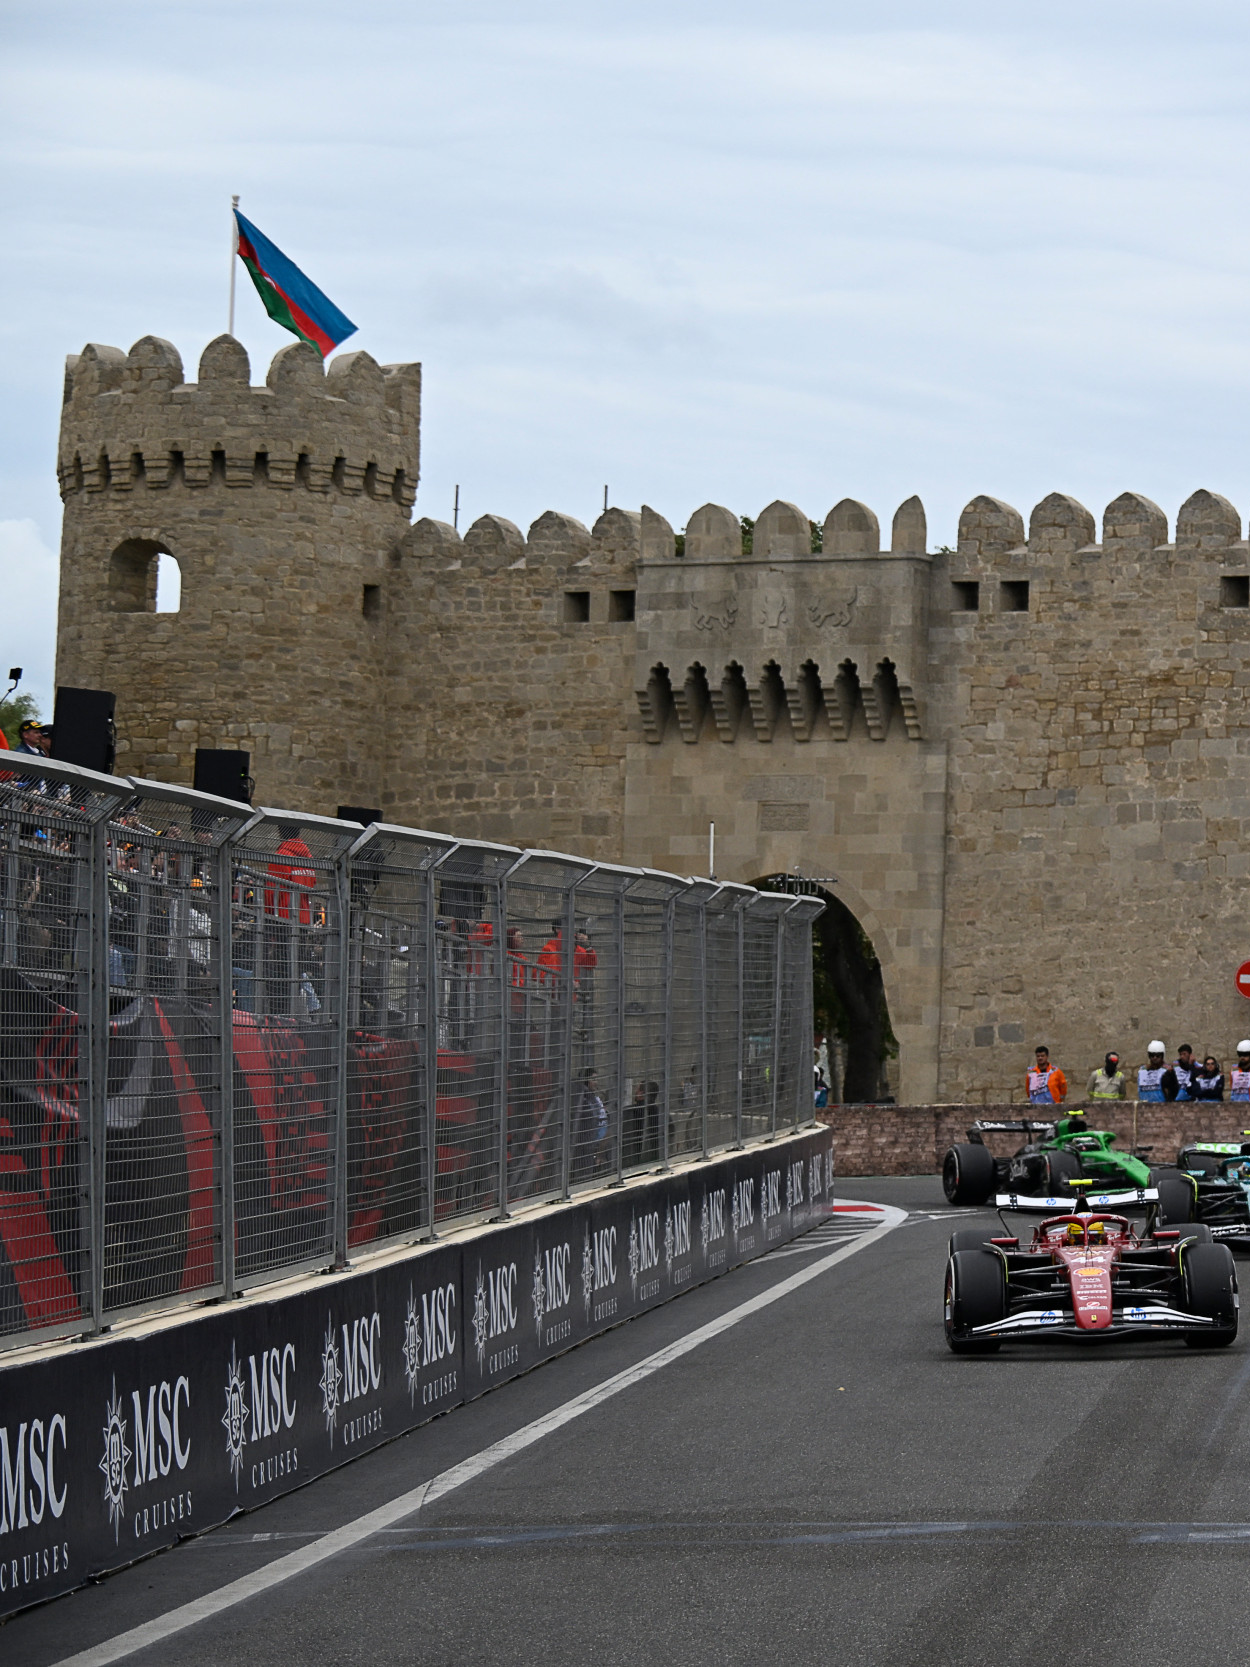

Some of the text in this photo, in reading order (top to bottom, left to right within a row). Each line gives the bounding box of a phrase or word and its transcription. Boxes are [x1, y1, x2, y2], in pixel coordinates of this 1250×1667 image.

[594, 1225, 617, 1291] MSC
[639, 1211, 660, 1272] MSC
[489, 1262, 518, 1339] MSC
[545, 1242, 571, 1313] MSC
[342, 1311, 381, 1403] MSC
[422, 1282, 456, 1367] MSC
[249, 1343, 297, 1442] MSC
[422, 1371, 457, 1406] CRUISES
[489, 1344, 519, 1375] CRUISES
[132, 1375, 191, 1487] MSC
[343, 1408, 382, 1446] CRUISES
[0, 1413, 67, 1535] MSC
[252, 1447, 298, 1489] CRUISES
[134, 1490, 192, 1538] CRUISES
[0, 1541, 69, 1592] CRUISES
